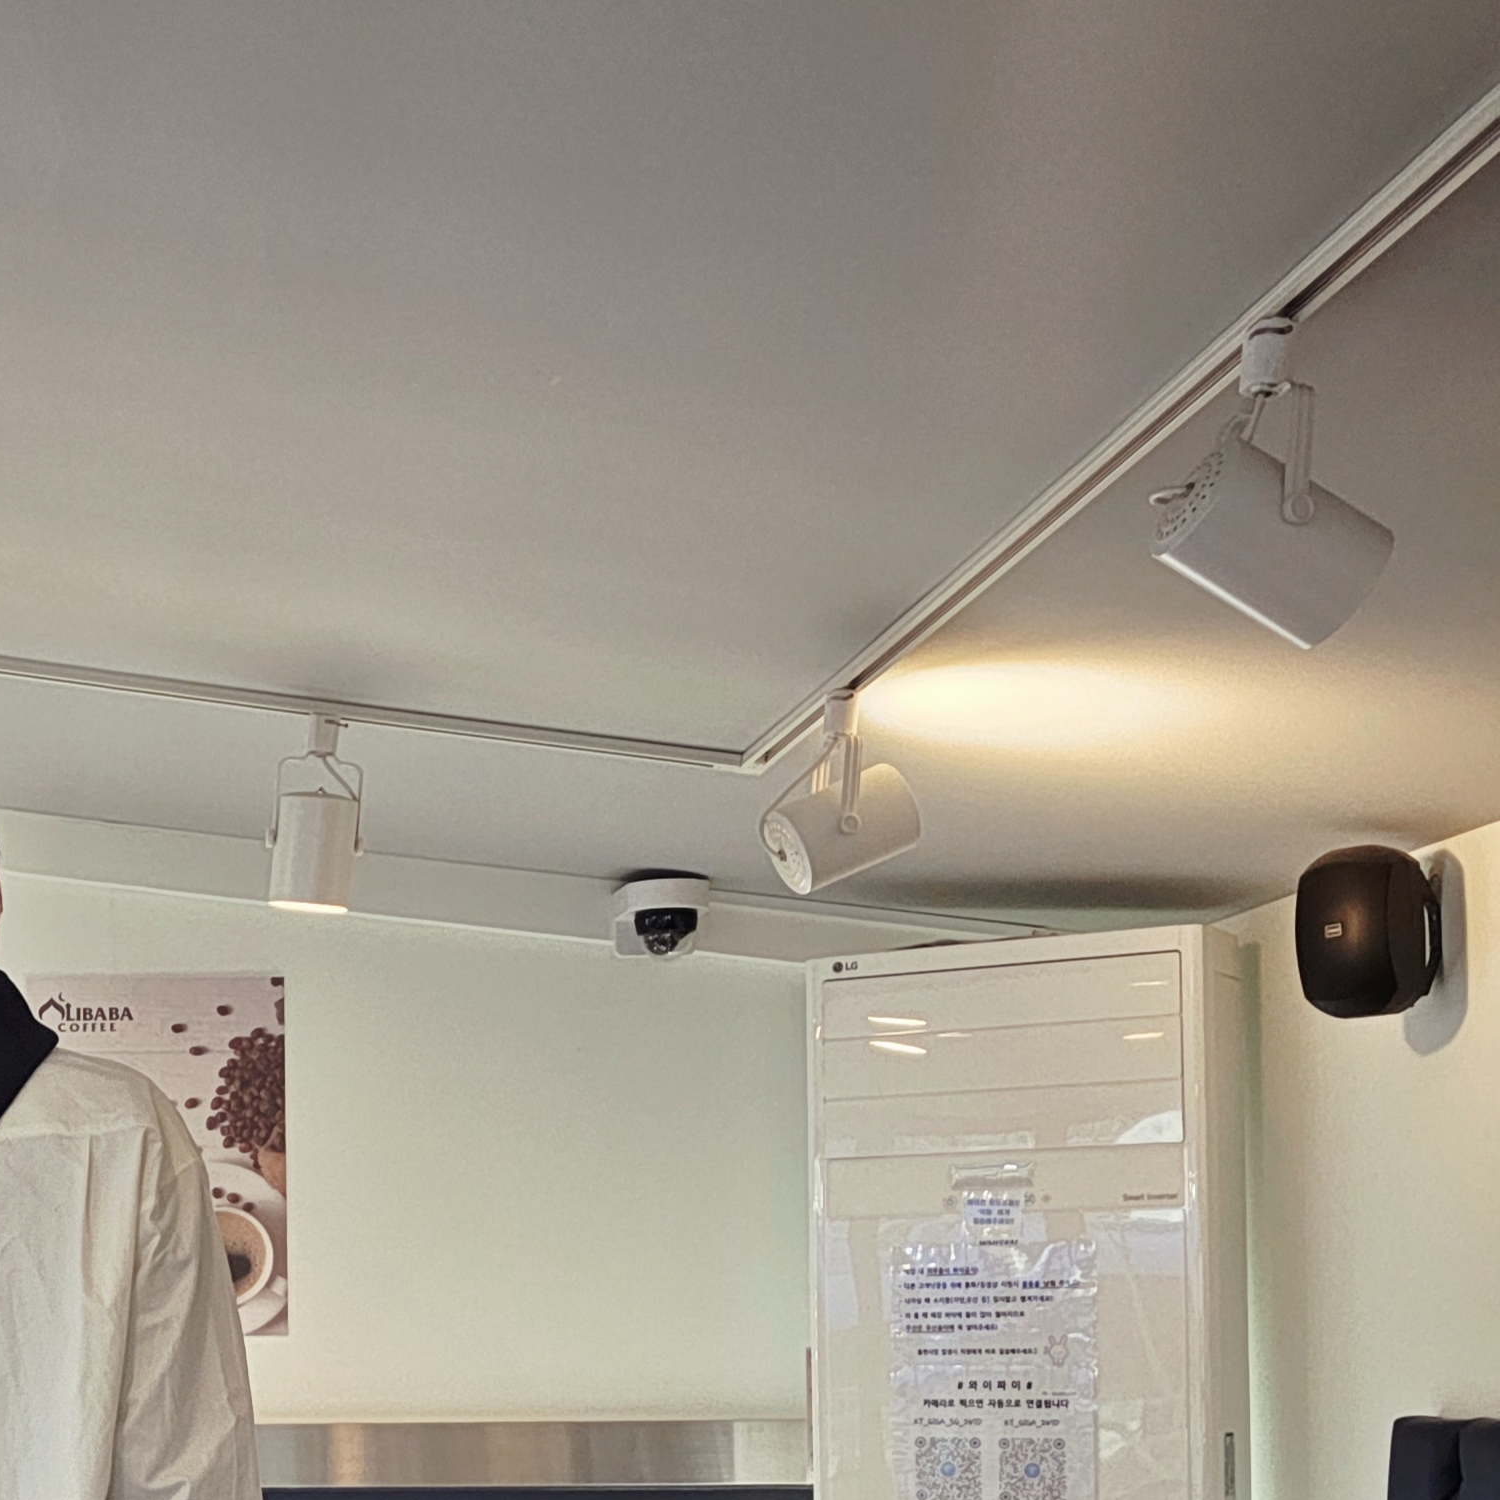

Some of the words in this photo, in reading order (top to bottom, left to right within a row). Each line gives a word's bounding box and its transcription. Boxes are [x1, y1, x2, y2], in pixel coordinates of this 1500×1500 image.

[844, 961, 859, 971] LG
[58, 1022, 117, 1033] COFFEE
[903, 1281, 916, 1290] 다른
[923, 1398, 955, 1408] 카메라로
[959, 1398, 984, 1409] 찍으면
[987, 1398, 1022, 1409] 자동으로
[1026, 1398, 1070, 1409] 연결됩니다
